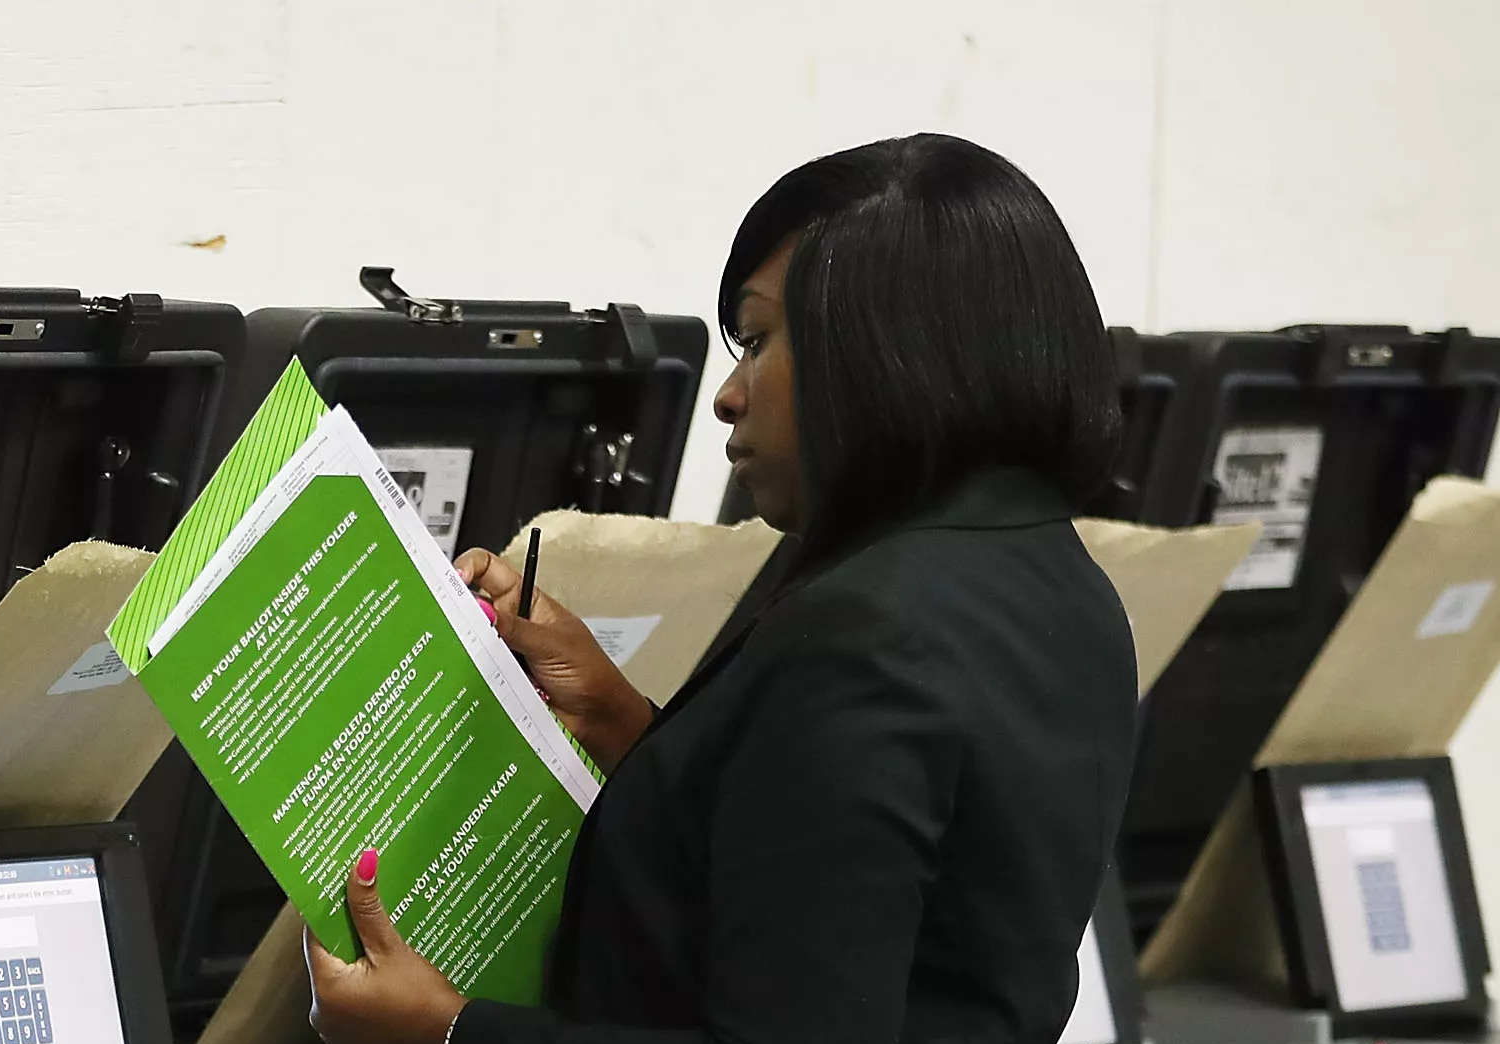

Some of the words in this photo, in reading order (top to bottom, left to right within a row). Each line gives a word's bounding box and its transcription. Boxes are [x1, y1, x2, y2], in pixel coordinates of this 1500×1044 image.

[191, 674, 212, 701] KEEP
[213, 644, 242, 676] YOUR
[240, 606, 272, 647] BALLOT
[272, 573, 303, 610] INSIDE
[300, 549, 322, 575] THIS
[321, 511, 357, 553] FOLDER
[213, 713, 230, 731] When
[229, 689, 250, 714] finished
[249, 667, 271, 691] marking
[269, 653, 282, 669] your
[296, 617, 312, 636] insert
[311, 586, 338, 619] completed
[356, 553, 368, 566] into
[367, 542, 377, 554] this
[256, 632, 267, 650] AT
[268, 616, 284, 637] ALL
[281, 584, 309, 616] TIMES
[206, 705, 222, 722] Mark
[221, 691, 233, 707] your
[232, 674, 248, 693] ballot
[248, 667, 254, 676] at
[253, 658, 263, 669] the
[262, 638, 281, 660] privacy
[279, 619, 297, 638] booth.
[218, 716, 237, 740] privacy
[273, 764, 322, 823] MANTENGA
[320, 747, 333, 766] SU
[333, 712, 366, 751] BOLETA
[364, 669, 400, 713] DENTRO
[400, 653, 413, 671] DE
[411, 631, 433, 656] ESTA
[302, 769, 334, 807] FUNDA
[332, 753, 345, 771] EN
[343, 722, 371, 755] TODO
[371, 668, 416, 725] MOMENTO
[389, 893, 413, 926] ILTEN
[411, 871, 430, 895] VÒT
[428, 859, 439, 873] W
[439, 843, 453, 863] AN
[452, 794, 492, 847] ANDEDAN
[490, 763, 517, 797] KATAB
[424, 877, 445, 902] SA-A
[442, 834, 478, 877] TOUTAN
[2, 998, 9, 1011] 5
[19, 996, 26, 1009] 6
[14, 966, 21, 980] 3
[7, 1027, 14, 1040] 8
[24, 1026, 31, 1039] 9
